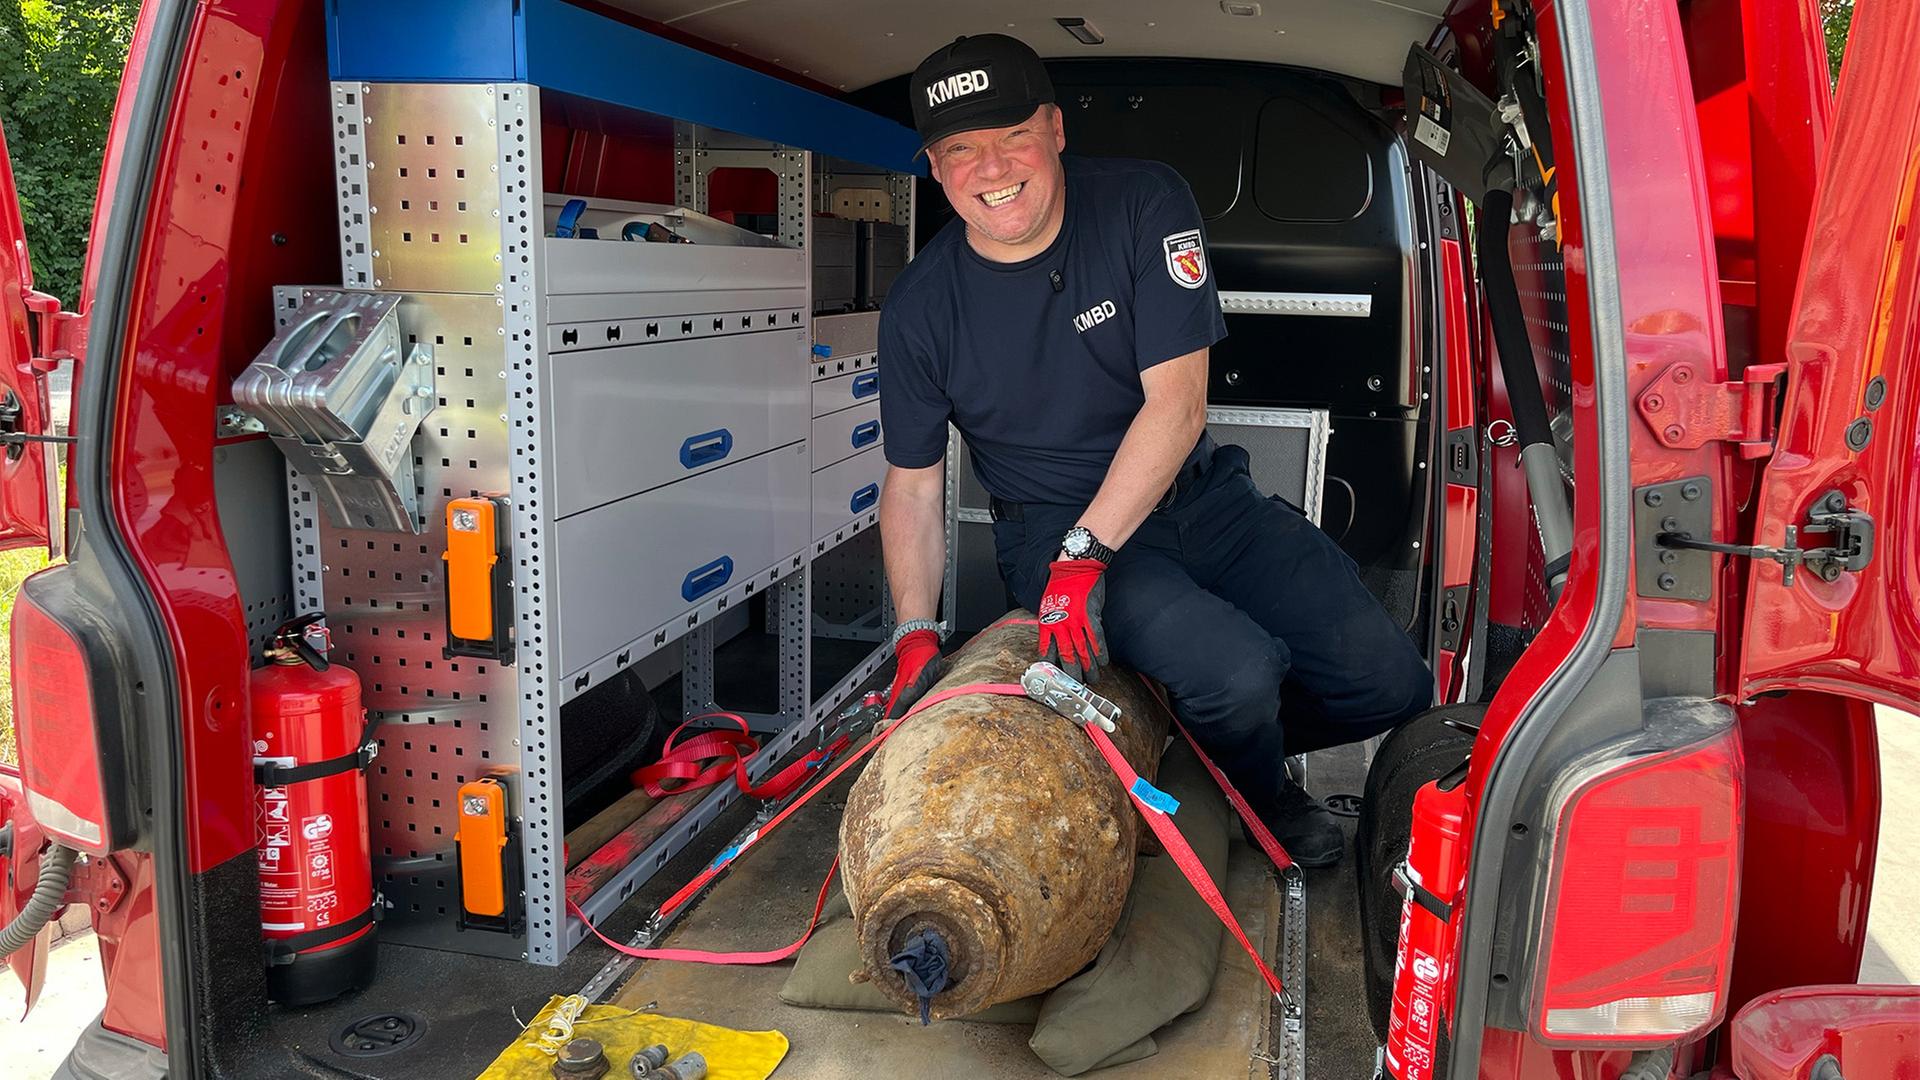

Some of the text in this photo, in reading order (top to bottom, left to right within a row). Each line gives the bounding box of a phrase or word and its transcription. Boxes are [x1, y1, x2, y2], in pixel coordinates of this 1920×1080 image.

[926, 69, 989, 107] KMBD
[1073, 300, 1116, 334] KMBD
[303, 815, 332, 840] GS
[307, 895, 338, 912] 2023
